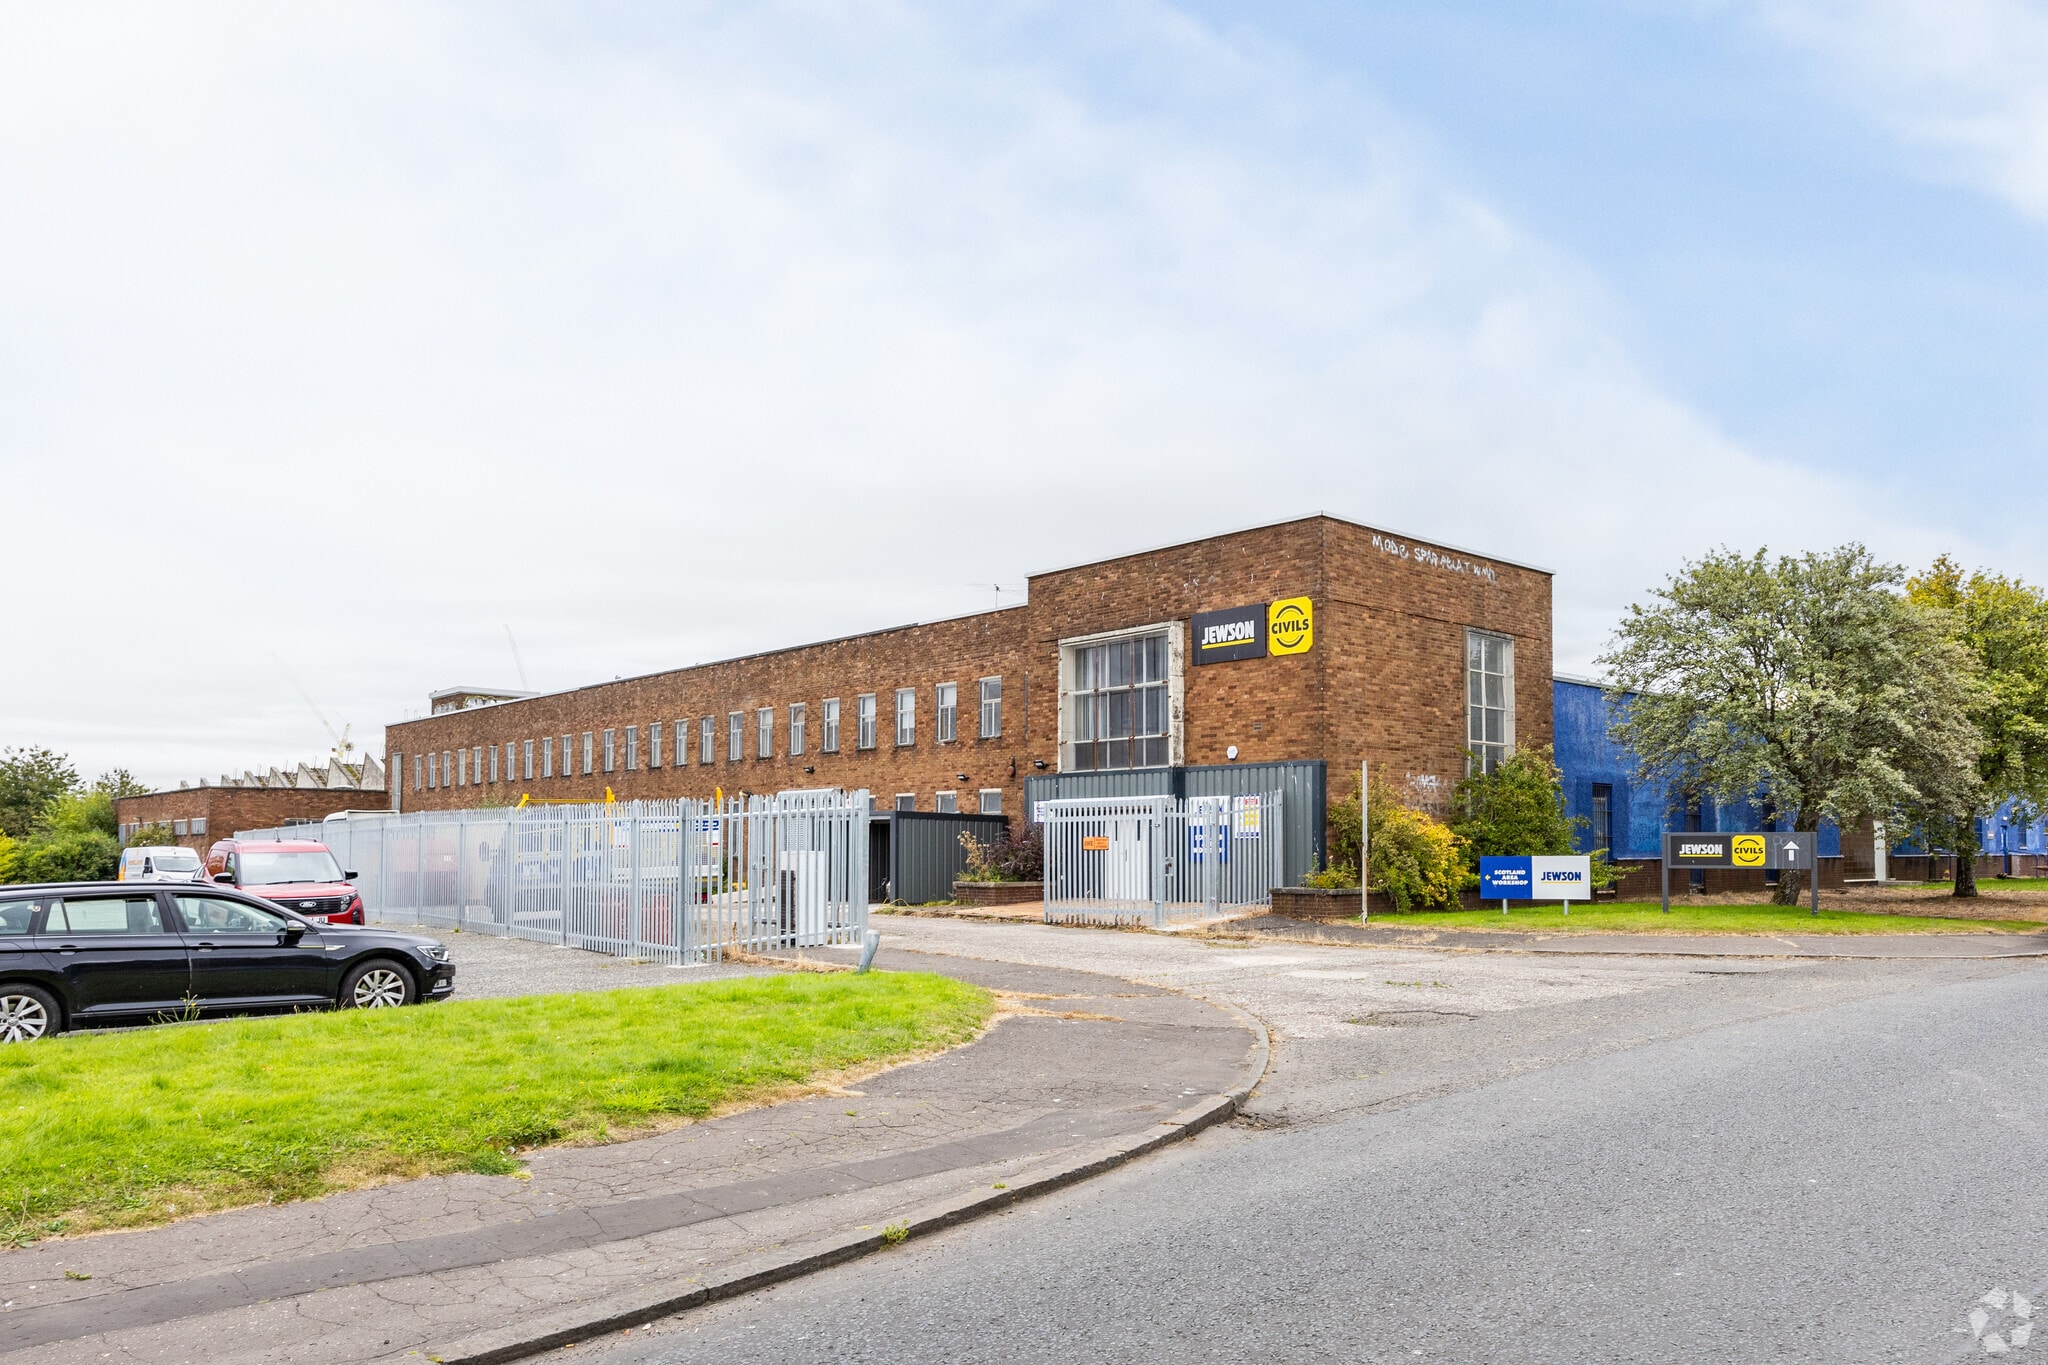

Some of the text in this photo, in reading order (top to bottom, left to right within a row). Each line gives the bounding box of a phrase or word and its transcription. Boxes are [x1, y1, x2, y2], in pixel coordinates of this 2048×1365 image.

[1202, 620, 1255, 645] JEWSON
[1271, 618, 1310, 635] CIVILS
[1679, 844, 1723, 855] JEWSON
[1540, 871, 1582, 881] JEWSON
